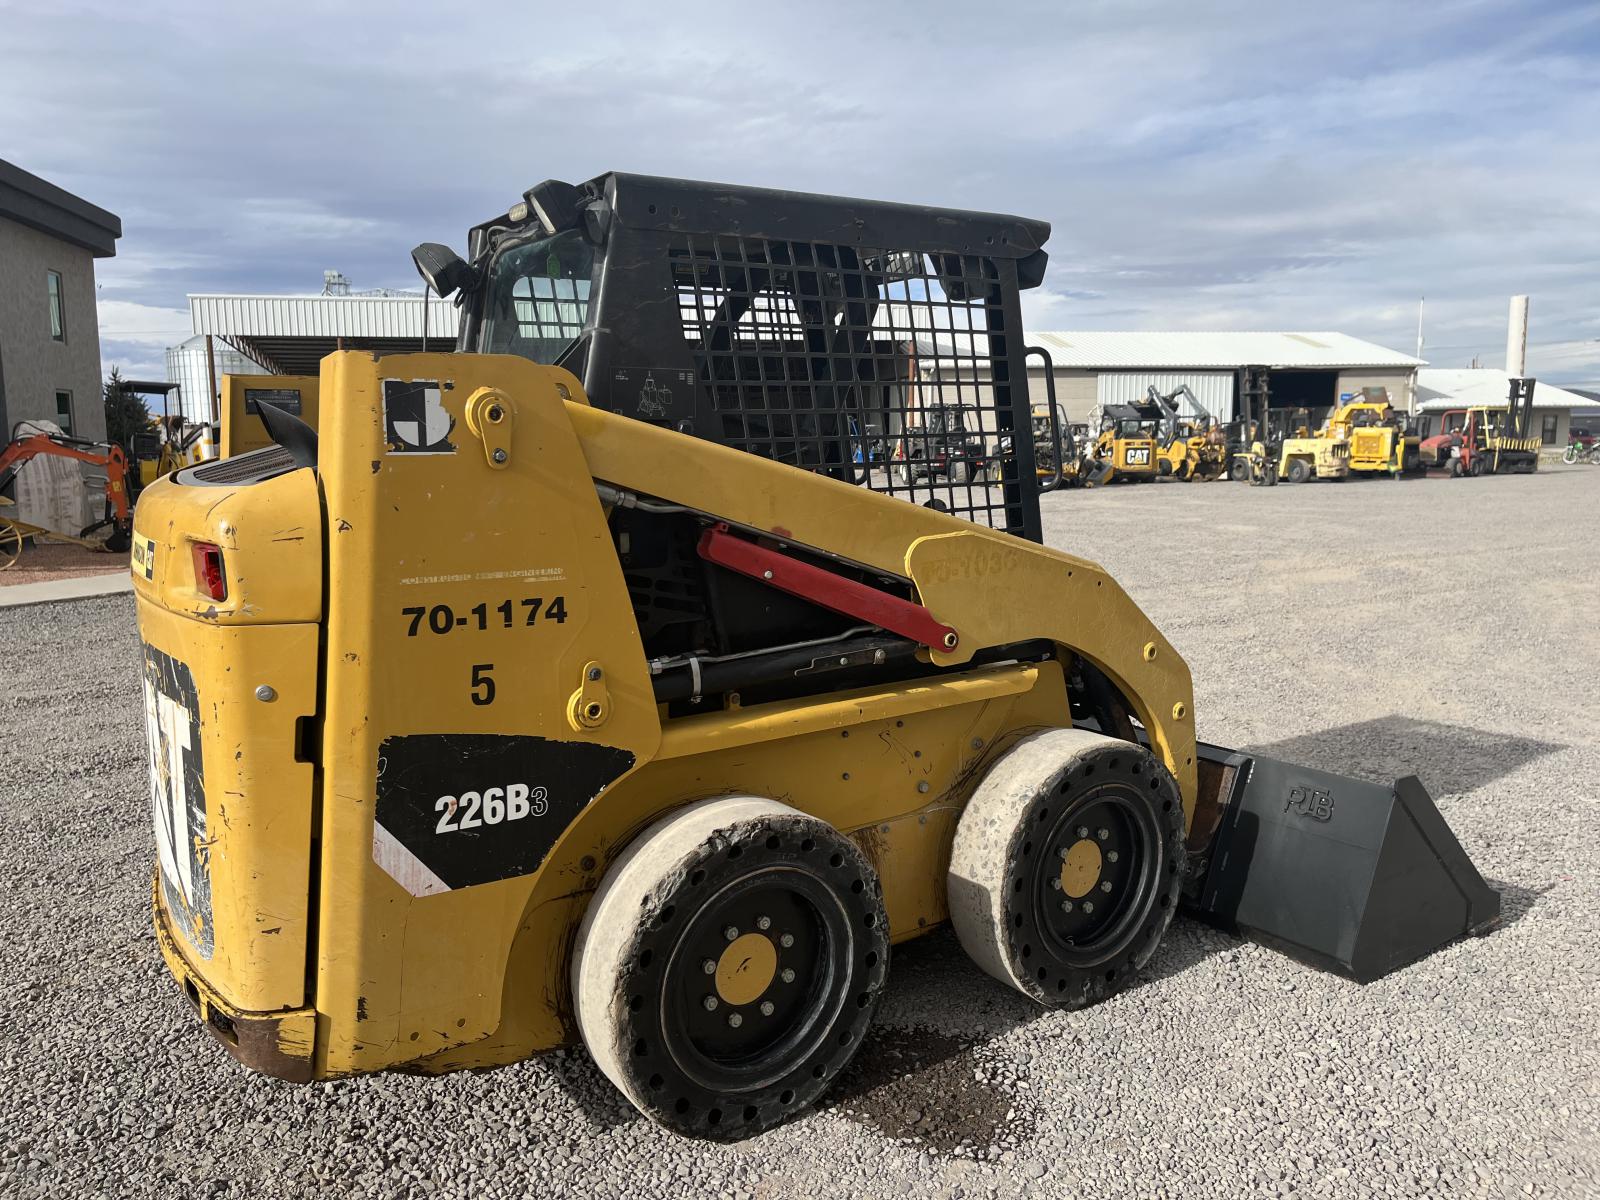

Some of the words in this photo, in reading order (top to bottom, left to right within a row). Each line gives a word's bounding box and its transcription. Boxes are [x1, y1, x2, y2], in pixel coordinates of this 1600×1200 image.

[1127, 449, 1149, 464] CAT
[401, 596, 568, 637] 70-1174
[470, 664, 496, 705] 5
